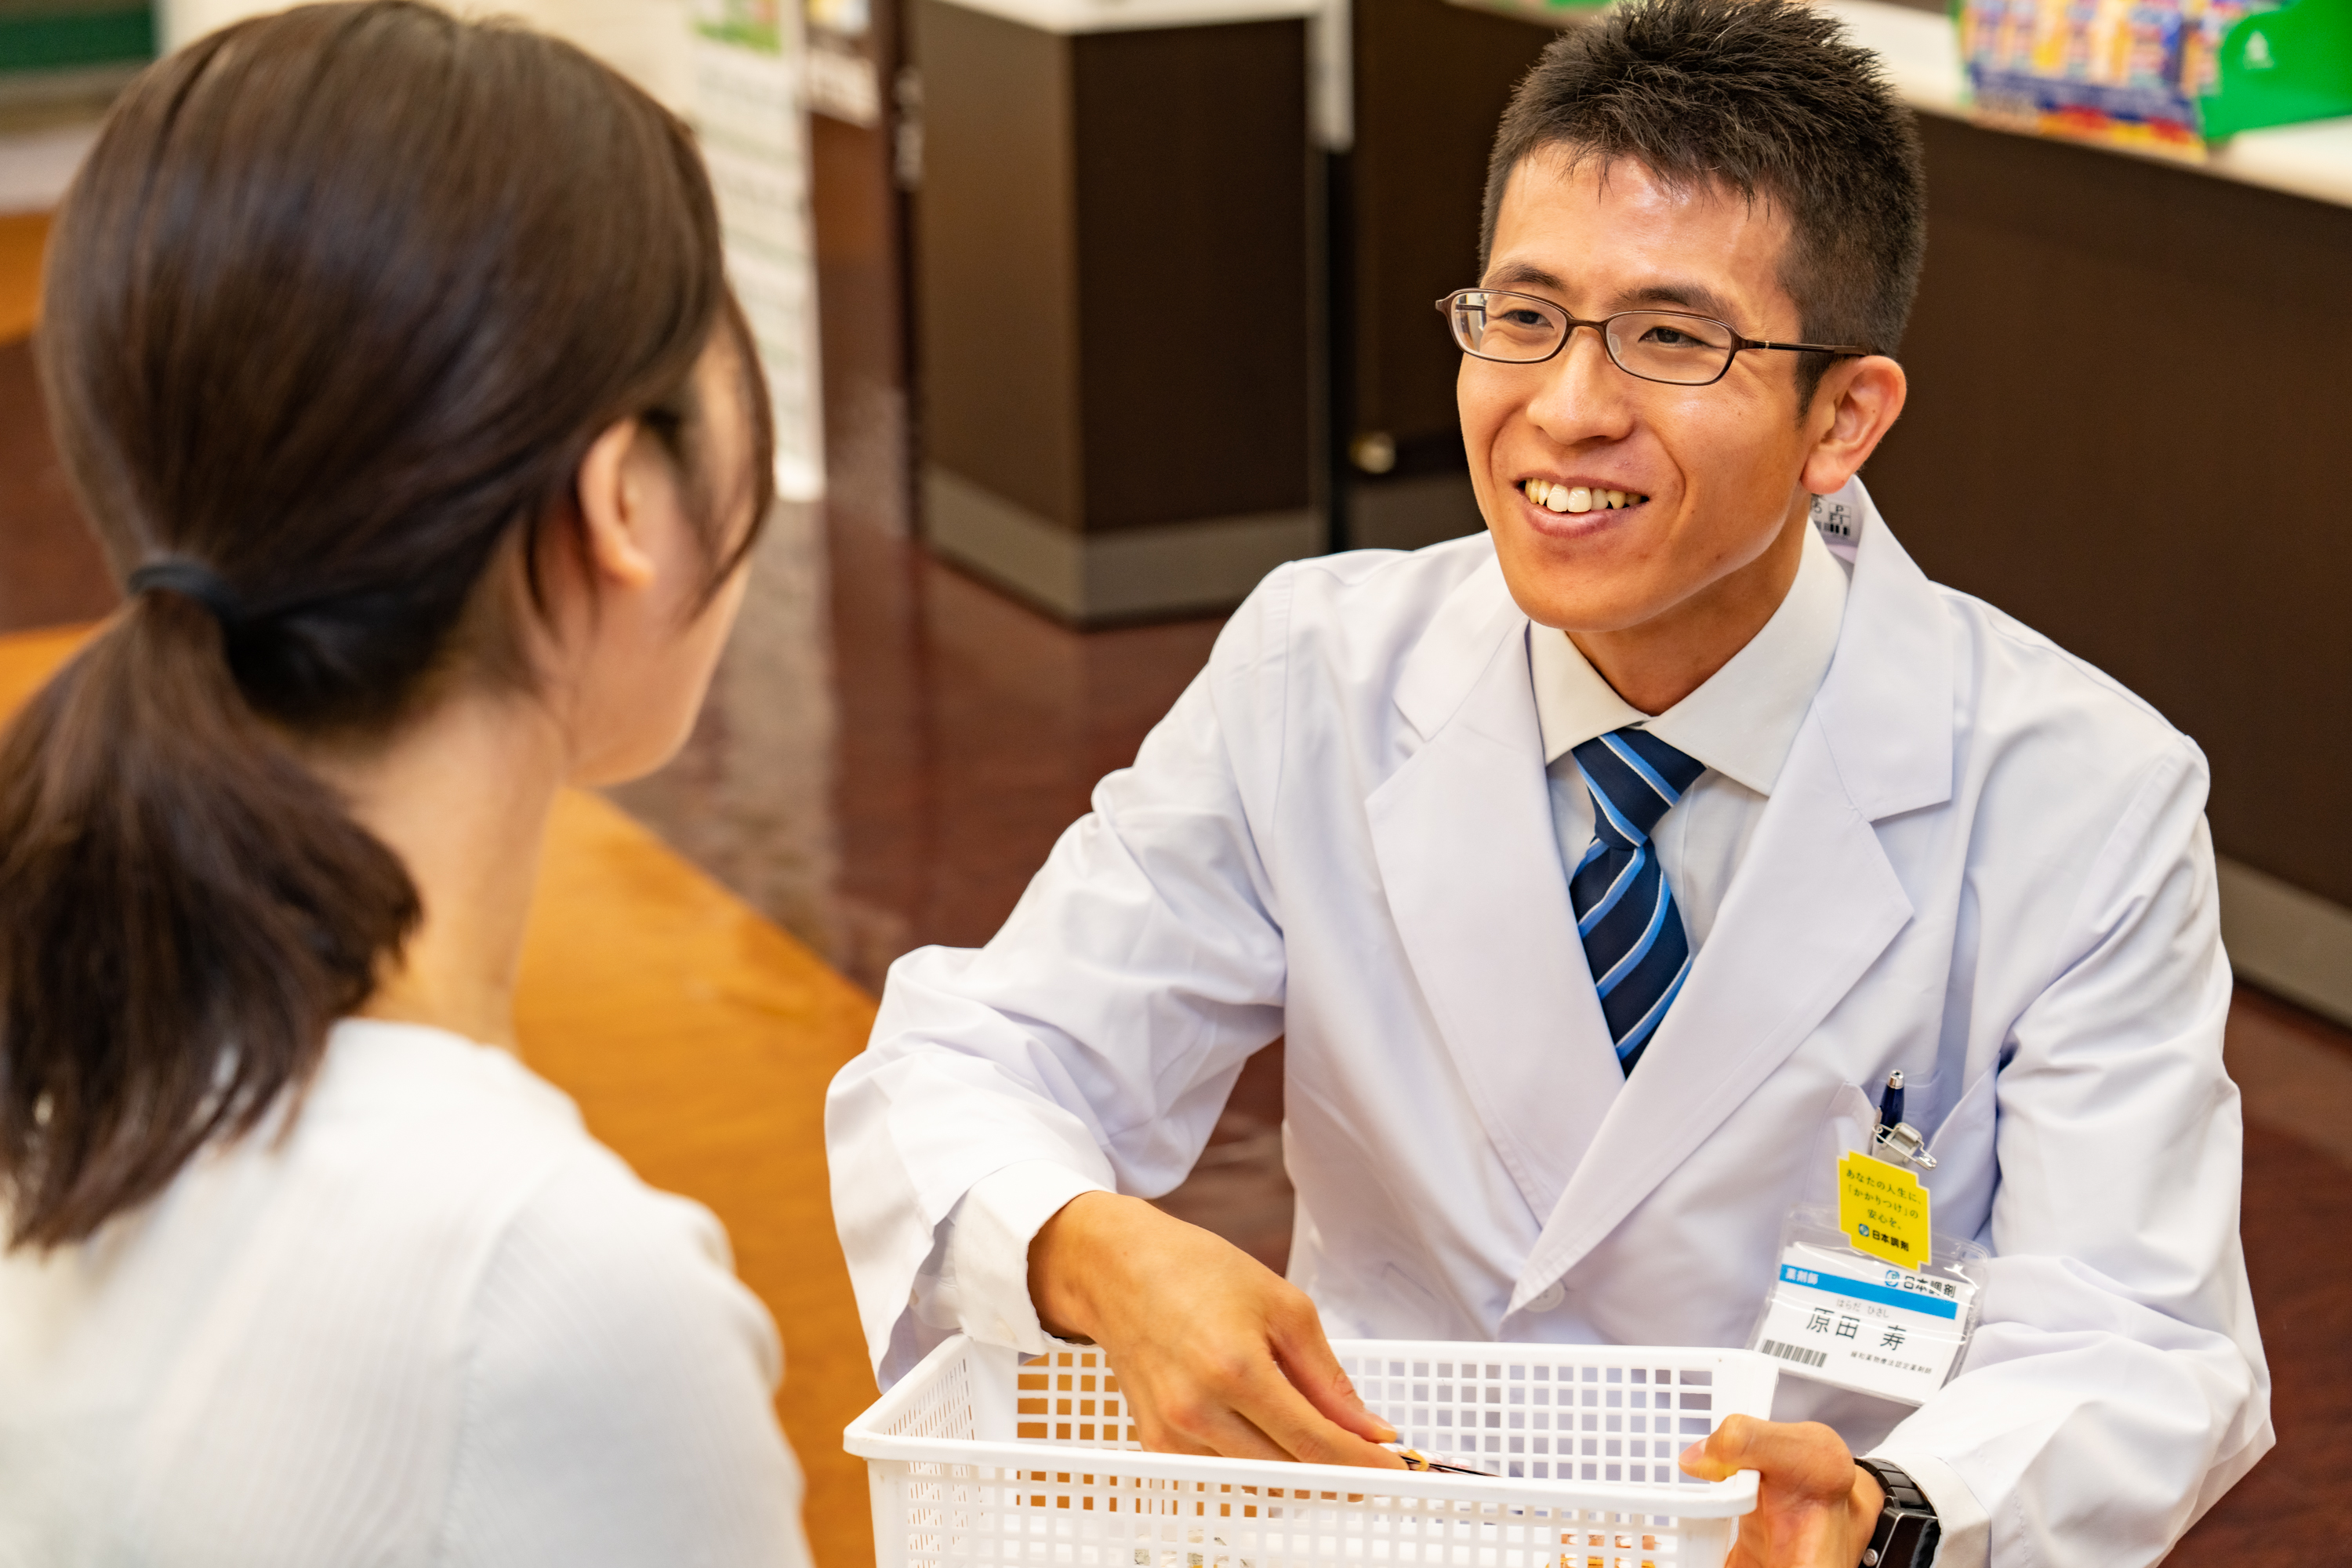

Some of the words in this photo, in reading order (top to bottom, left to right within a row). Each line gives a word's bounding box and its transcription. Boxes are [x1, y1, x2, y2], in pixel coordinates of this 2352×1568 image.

[1846, 1169, 1922, 1205] あなたの人生に、
[1849, 1184, 1919, 1219] 「かかりつけ」の
[1867, 1208, 1902, 1230] 安心を。
[1872, 1229, 1910, 1252] 日本調剤
[1904, 1276, 1957, 1298] 日本調剤
[1837, 1298, 1861, 1312] はらだ
[1806, 1307, 1860, 1340] 原田
[1880, 1324, 1907, 1351] 寿
